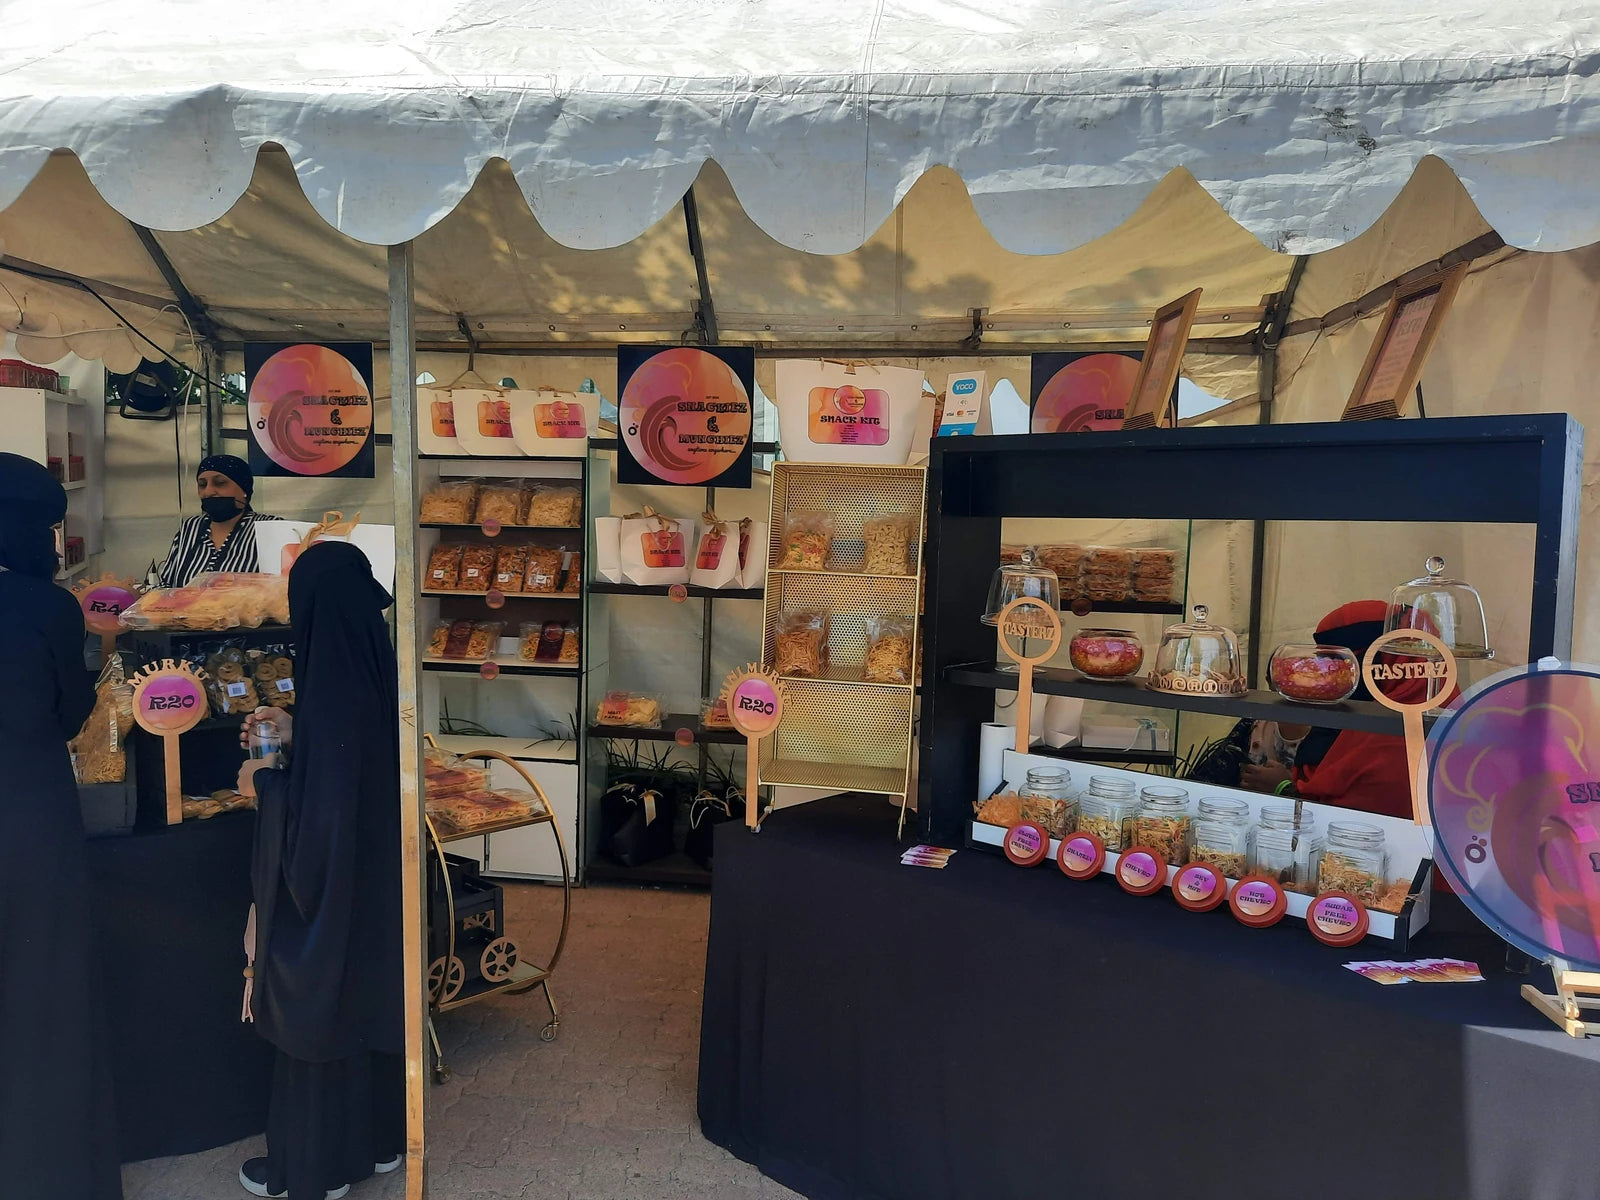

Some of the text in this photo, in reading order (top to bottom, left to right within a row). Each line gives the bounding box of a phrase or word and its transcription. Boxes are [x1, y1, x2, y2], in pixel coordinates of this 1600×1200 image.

[302, 395, 368, 406] SNACKIEZ
[677, 401, 748, 413] SNACKIEZ
[330, 408, 343, 425] &
[820, 415, 880, 425] SNACK KIT
[1095, 408, 1125, 420] SNA
[706, 415, 720, 433] &
[304, 426, 367, 436] MUNCHIEZ
[678, 434, 744, 445] MUNCHIEZ
[89, 600, 121, 616] R4
[1003, 621, 1055, 640] TASTERZ
[127, 658, 211, 689] MURKU
[1371, 661, 1449, 680] TASTERZ
[148, 694, 195, 710] R20
[738, 695, 774, 716] R20
[1125, 862, 1151, 878] CHEVRO
[1239, 895, 1271, 905] CHEVRO
[1249, 890, 1265, 899] HOT
[1324, 902, 1353, 912] SUGAR
[1317, 915, 1352, 927] CHEVRO
[1324, 910, 1347, 920] FREE
